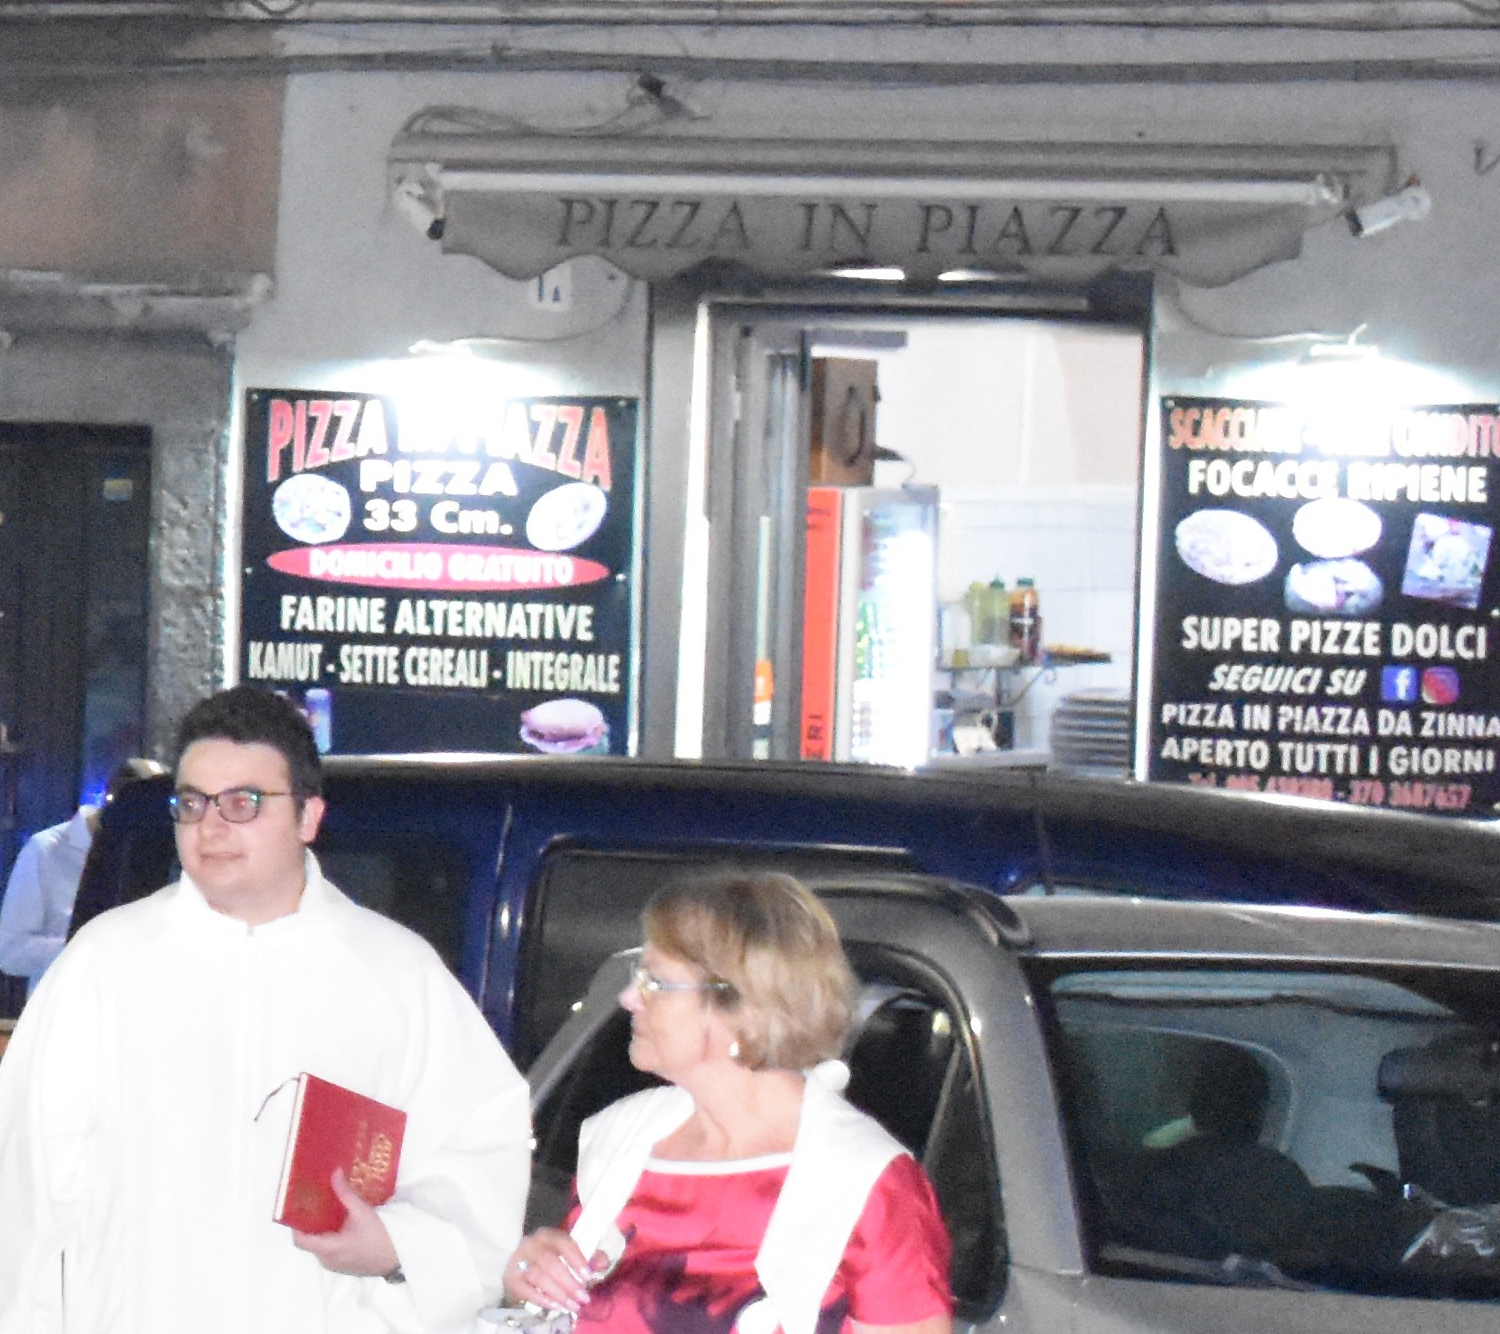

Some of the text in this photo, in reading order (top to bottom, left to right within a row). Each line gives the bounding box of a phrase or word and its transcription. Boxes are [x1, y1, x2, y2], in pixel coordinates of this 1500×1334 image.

[555, 198, 1183, 257] PIZZA IN PIAZZA
[267, 399, 389, 482] PIZZA
[359, 459, 518, 496] PIZZA
[1189, 459, 1488, 503] FOCACCE RIPIENE
[363, 499, 513, 535] 33 Cm.
[309, 550, 575, 585] DOMICILIO GRATUITO
[279, 595, 595, 642] FARINE ALTERNATIVE
[1182, 615, 1488, 659] SUPER PIZZE DOLCI
[248, 641, 324, 681] KAMUT
[339, 645, 399, 685] SETTE
[404, 647, 488, 689] CEREALI
[506, 651, 621, 694] INTEGRALE
[1209, 664, 1321, 694] SEGUICI
[1326, 667, 1367, 696] SU
[1161, 703, 1500, 738] PIZZA IN PIAZZA DA ZINNA
[1160, 736, 1269, 770] APERTO
[1278, 741, 1360, 774] TUTTI
[1388, 746, 1495, 776] GIORNI
